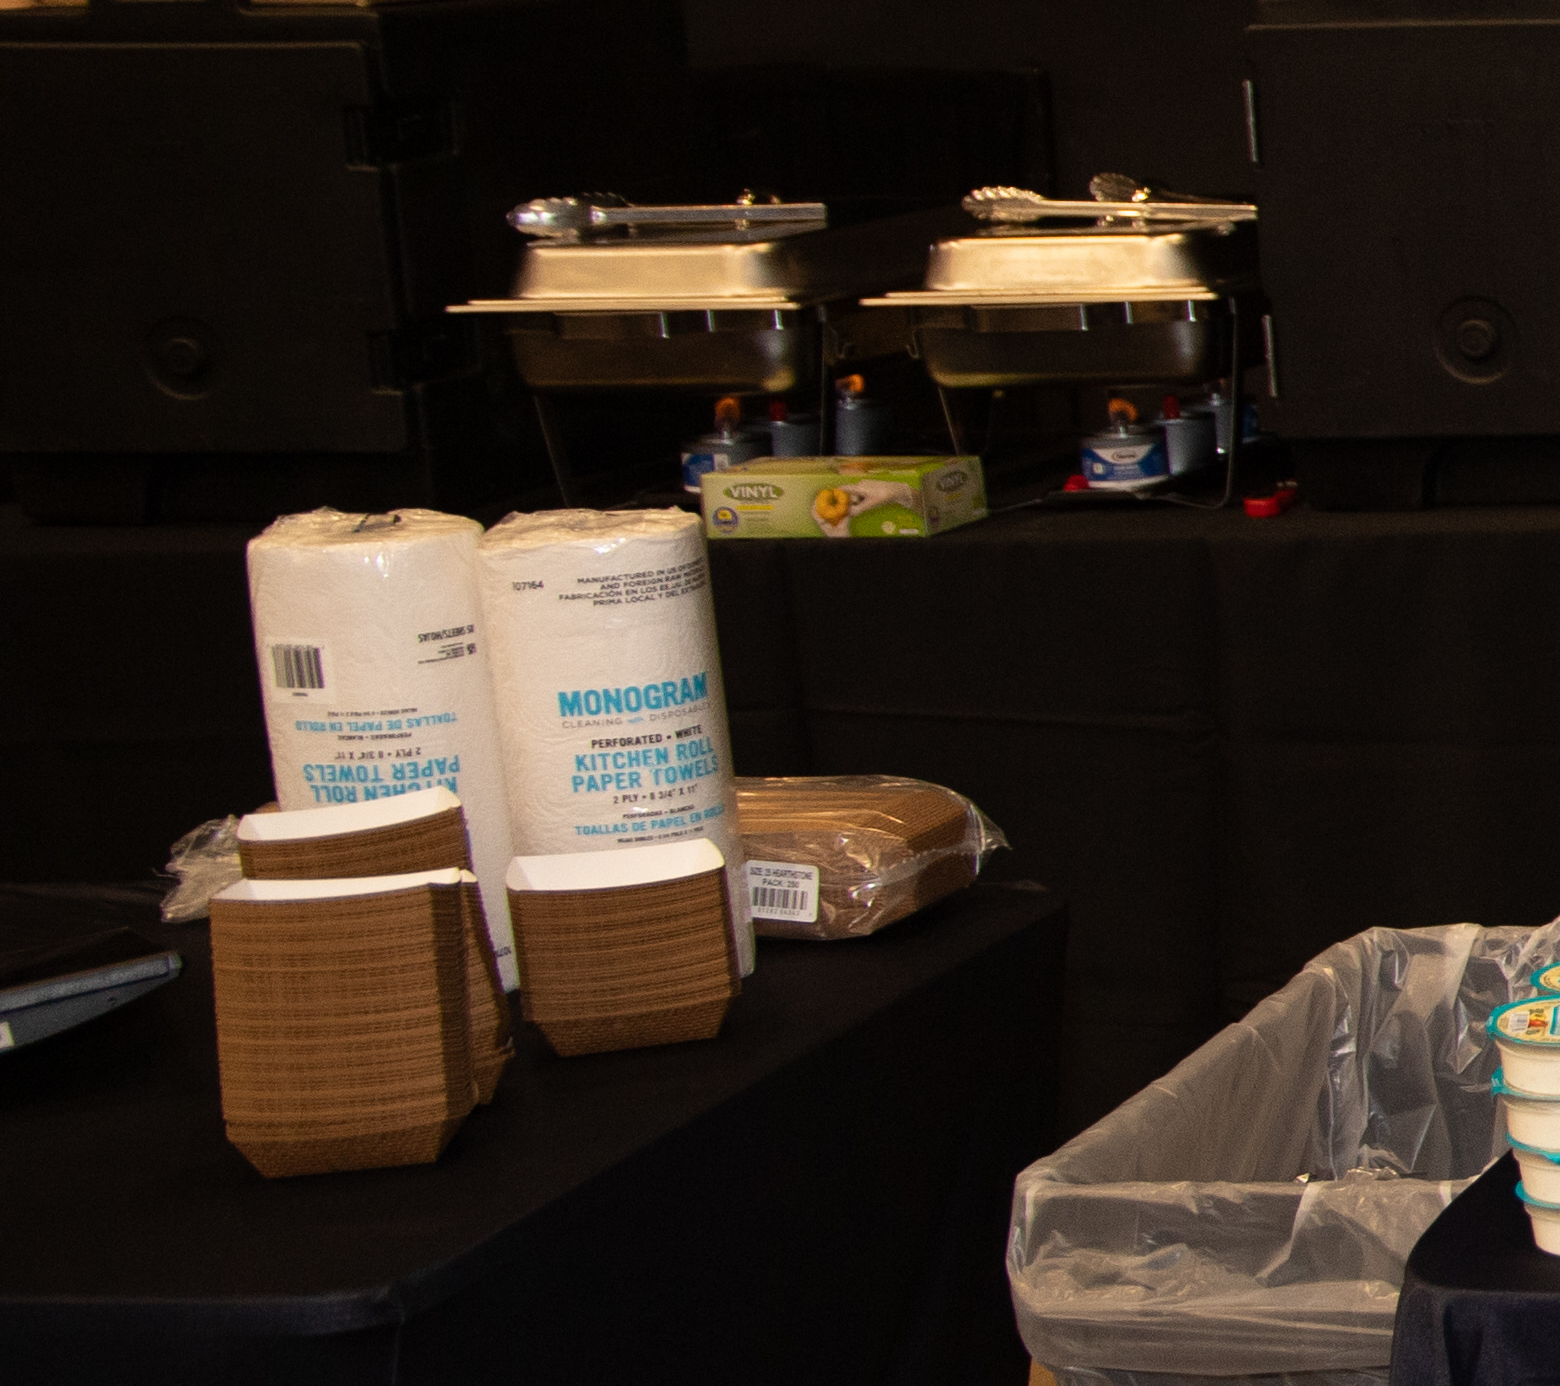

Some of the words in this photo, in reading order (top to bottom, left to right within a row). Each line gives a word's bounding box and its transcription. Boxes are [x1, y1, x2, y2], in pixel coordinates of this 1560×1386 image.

[730, 485, 777, 499] VINYL
[577, 570, 654, 584] MANUFACTURED
[600, 582, 620, 591] AND
[558, 671, 708, 717] MONOGRAM
[563, 718, 622, 729] CLEANING
[591, 734, 662, 748] PERFORATED
[675, 725, 702, 739] WHITE
[575, 747, 668, 771] KITCHEN
[675, 736, 713, 760] ROLL
[303, 763, 384, 783] TOWELS
[392, 755, 461, 780] PAPER
[571, 772, 641, 793] PAPER
[653, 755, 718, 786] TOWELS
[310, 784, 357, 803] ROLL
[575, 821, 628, 836] TOALLAS
[632, 821, 646, 831] DE
[651, 816, 686, 829] PAPEL
